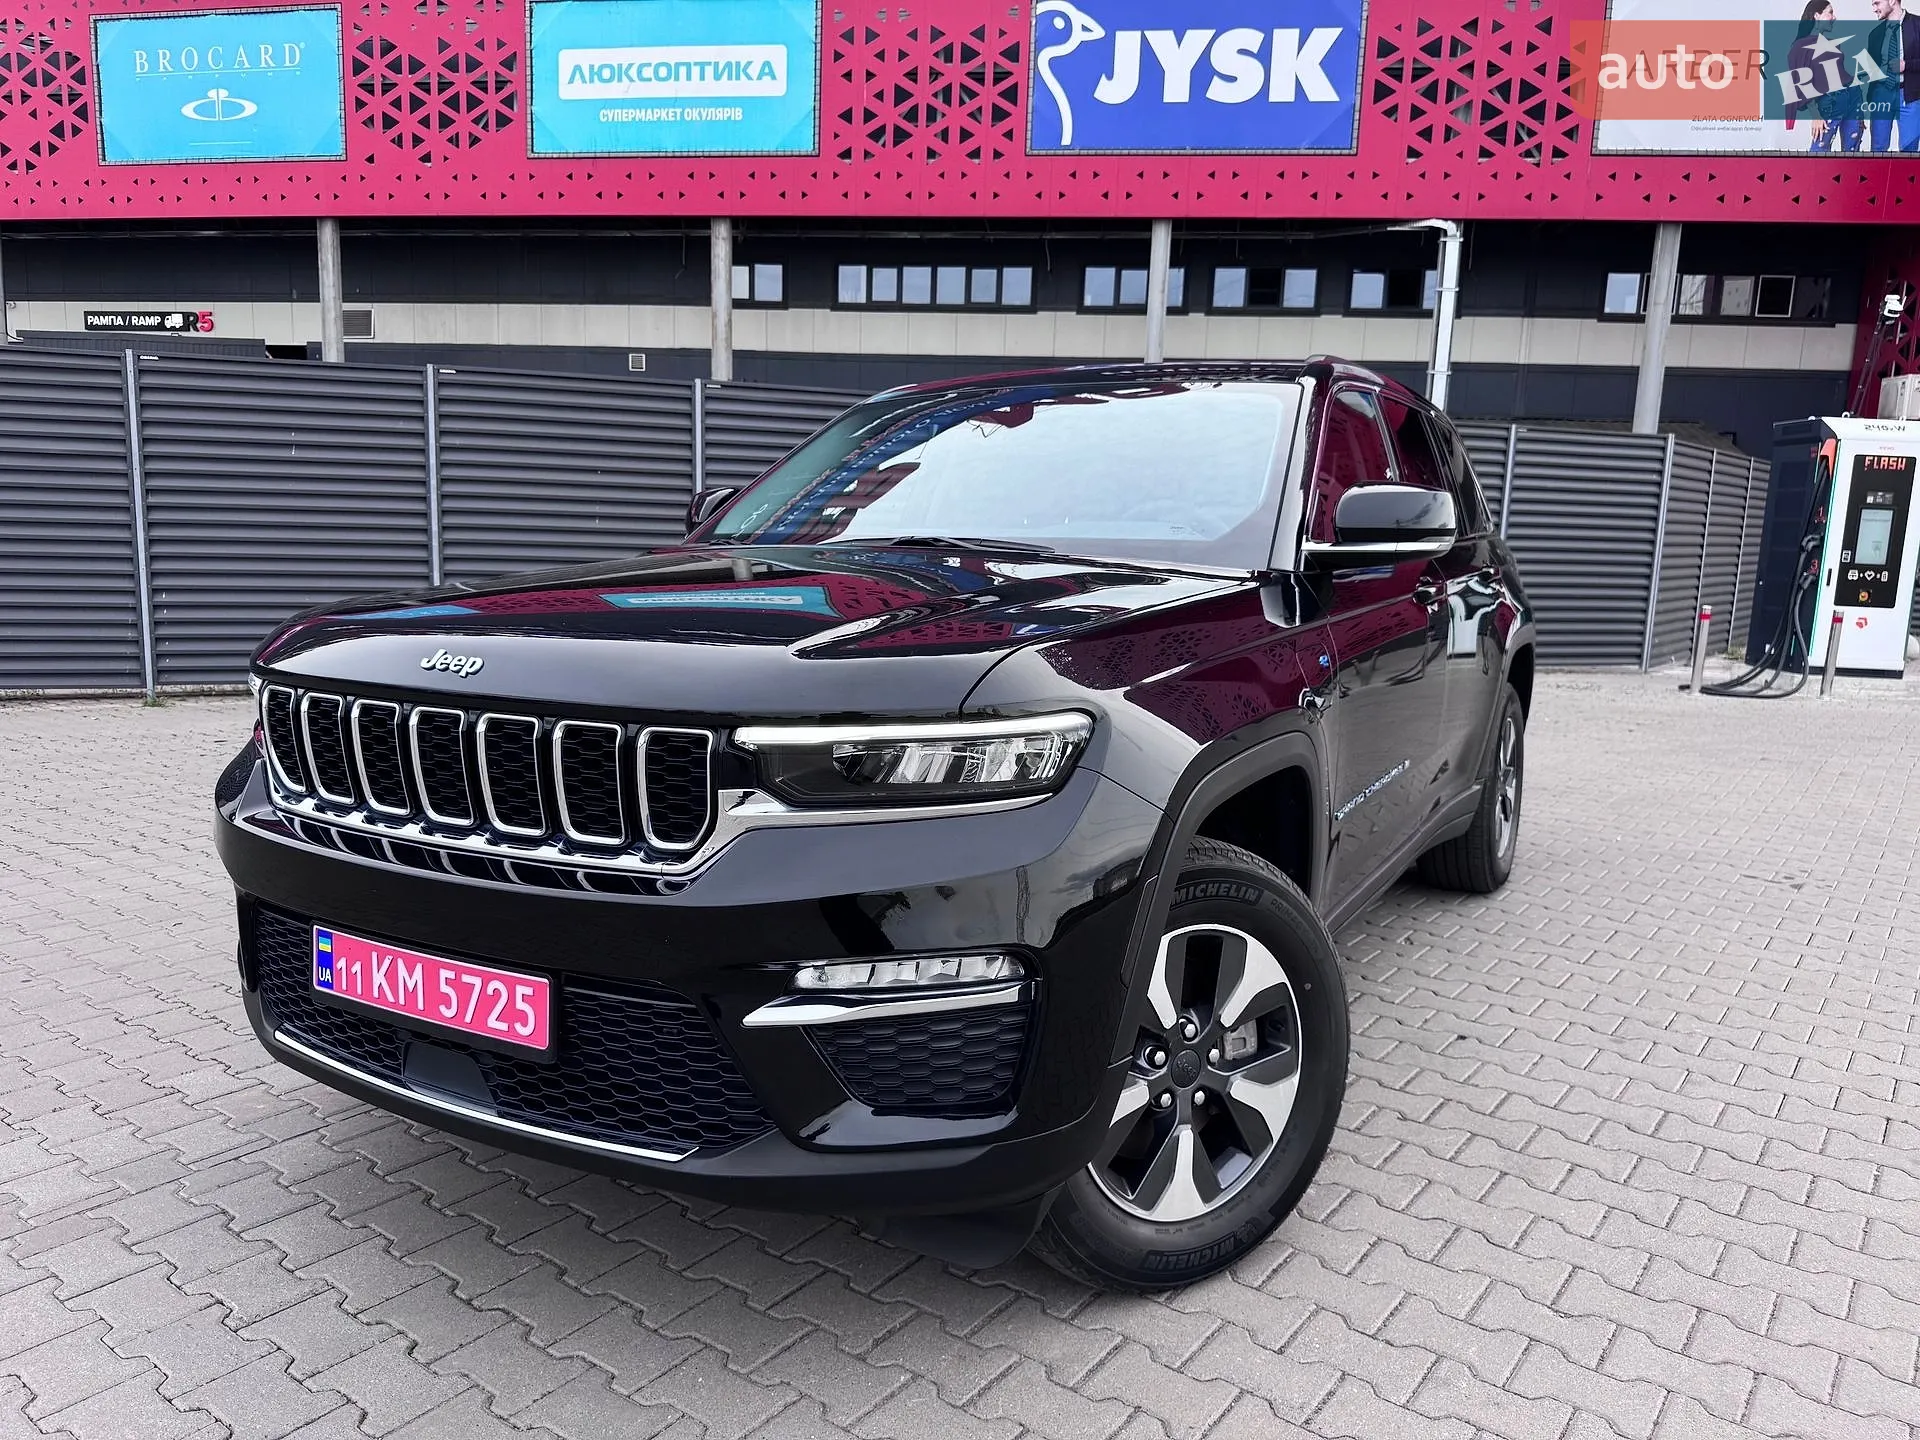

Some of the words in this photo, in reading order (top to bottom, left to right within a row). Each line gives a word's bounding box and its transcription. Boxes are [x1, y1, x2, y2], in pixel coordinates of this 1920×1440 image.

[134, 42, 301, 74] BROCARD
[567, 58, 778, 86] ЛЮКСОПТИКА
[1093, 27, 1344, 104] JYSK
[599, 107, 683, 122] СУПЕРМАРКЕТ
[684, 107, 744, 121] ОКУЛЯРІВ
[87, 315, 124, 326] РАМПА
[132, 315, 161, 326] RAMP
[1864, 456, 1906, 471] FLASH
[420, 648, 485, 678] Jeep
[1172, 882, 1261, 906] MICHELIN
[319, 966, 332, 983] UA
[336, 955, 363, 996] 11
[370, 951, 425, 1011] KM
[438, 968, 536, 1037] 5725
[1144, 1237, 1234, 1270] MICHELIN
